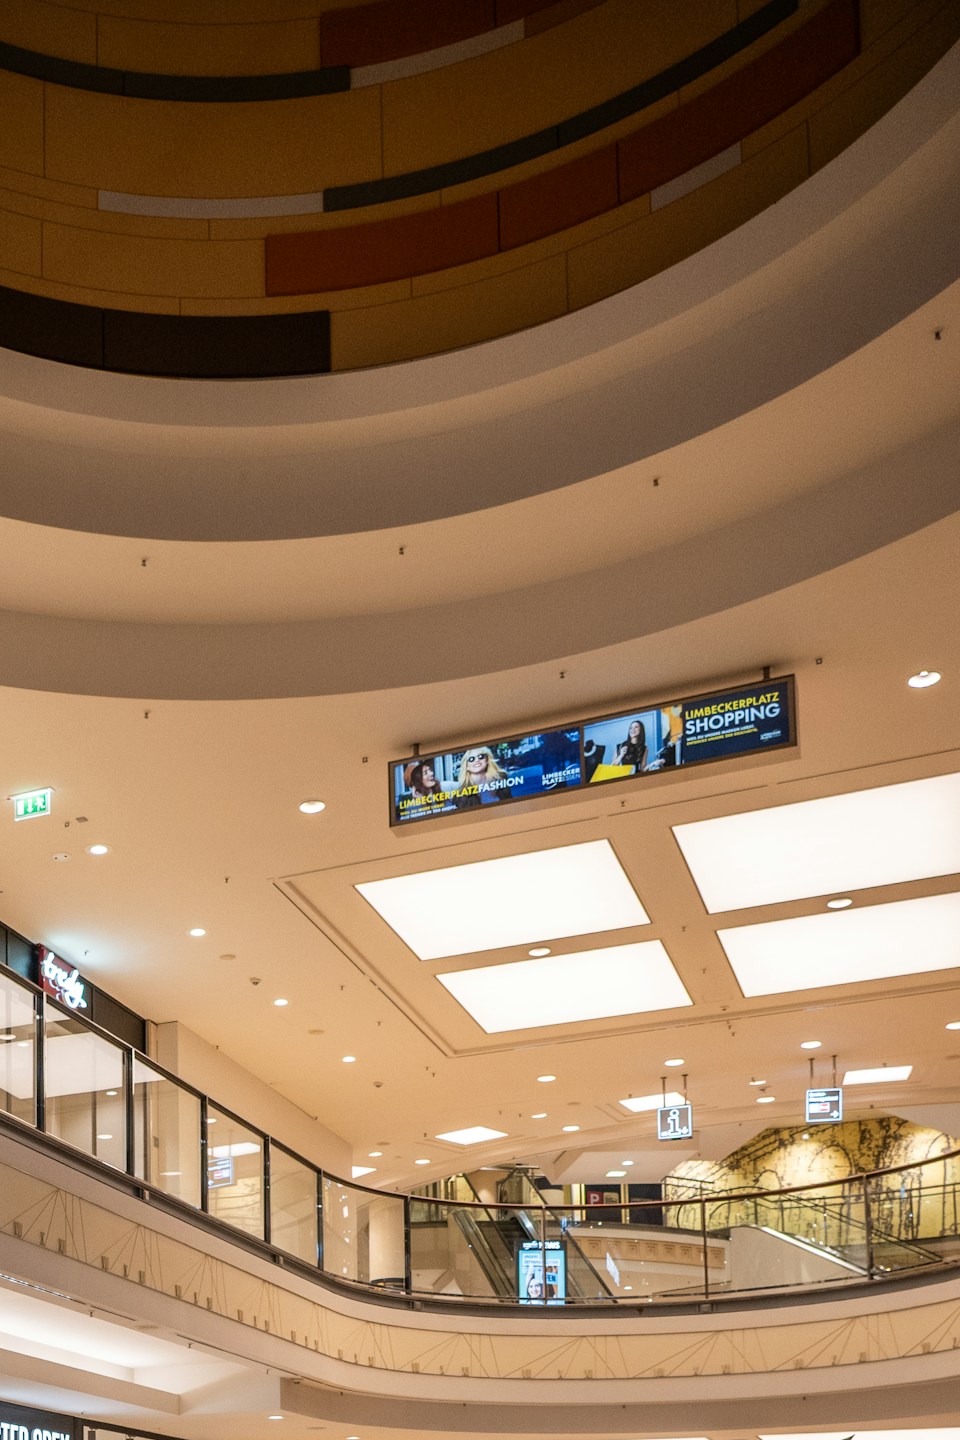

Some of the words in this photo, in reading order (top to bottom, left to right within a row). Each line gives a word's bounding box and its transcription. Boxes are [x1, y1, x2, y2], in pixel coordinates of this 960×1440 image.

[685, 692, 779, 720] LIMBECKERPLATZ
[685, 703, 781, 735] SHOPPING
[542, 768, 580, 782] LIMBECKER
